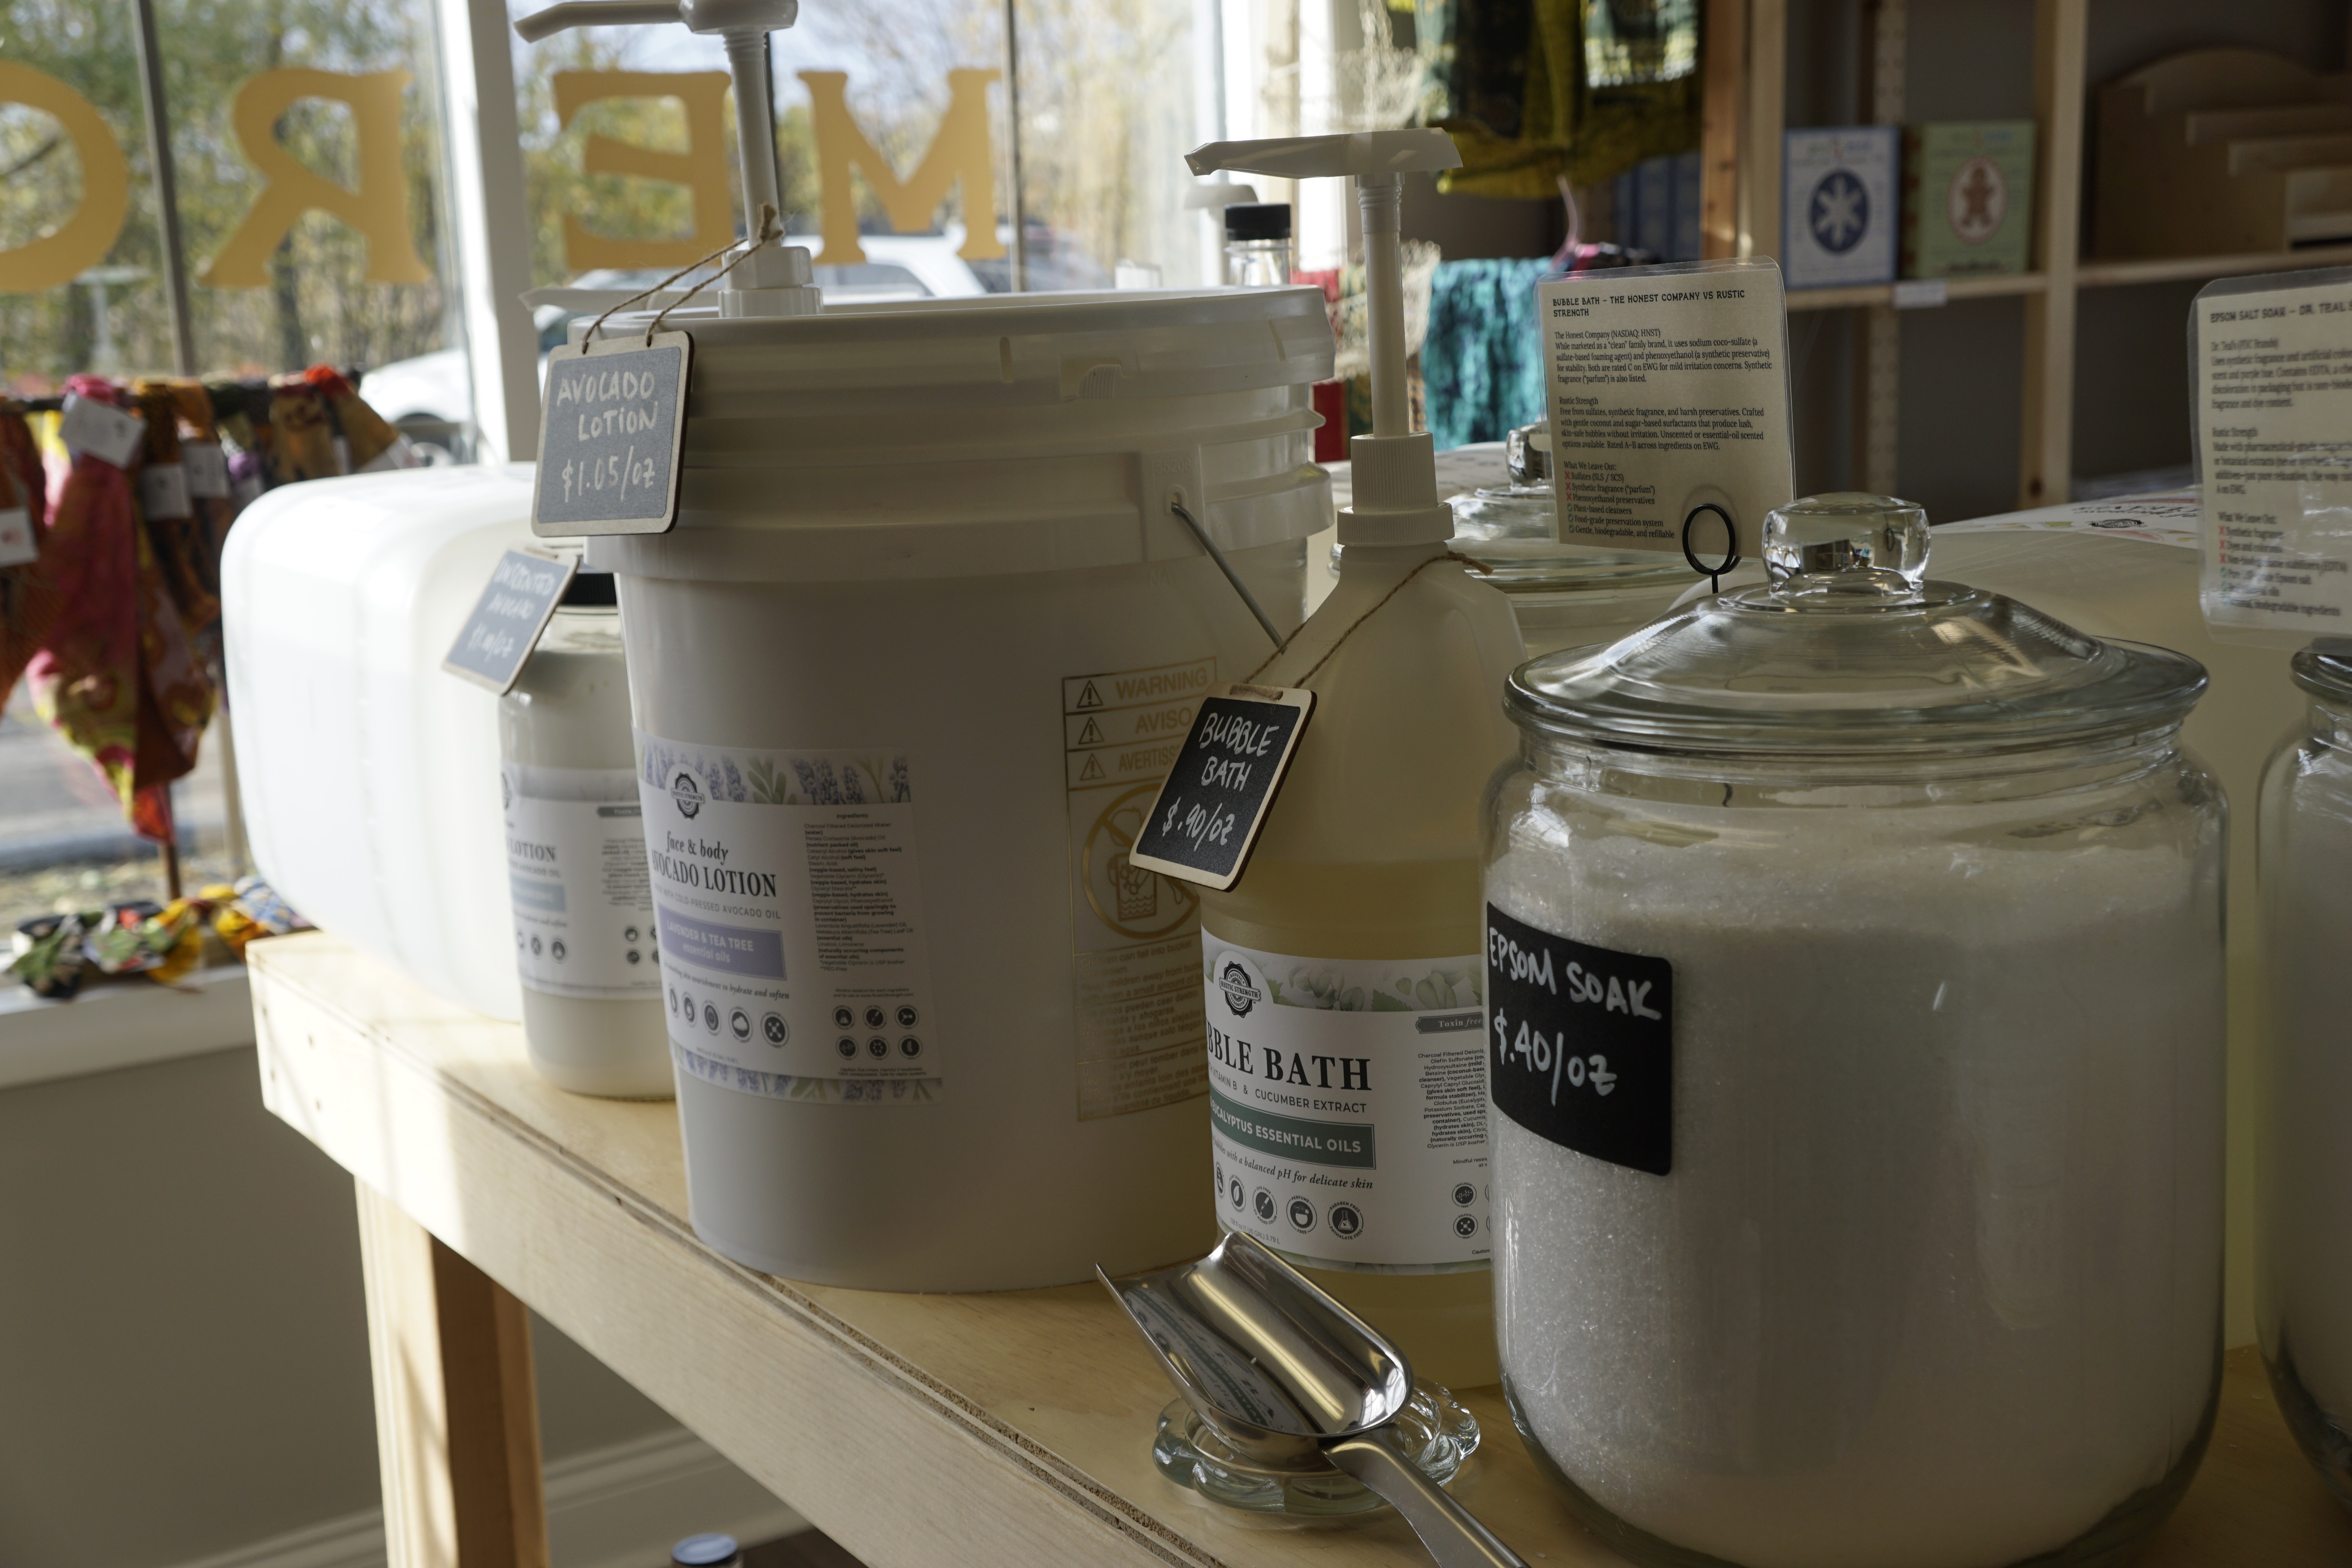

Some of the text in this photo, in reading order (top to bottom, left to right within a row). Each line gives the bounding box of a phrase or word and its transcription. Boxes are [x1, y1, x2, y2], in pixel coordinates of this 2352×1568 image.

[1552, 289, 1745, 307] BUBBLE BATH THE HONEST COMPANY VS RUSTIC
[1553, 308, 1589, 317] STRENGTH
[2211, 312, 2236, 323] EPSOM
[2239, 309, 2259, 320] SALT
[1554, 331, 1564, 339] The
[1584, 330, 1610, 340] Company
[1611, 329, 1640, 340] (NASDAQ:
[1641, 328, 1661, 338] HNST)
[1555, 341, 1570, 350] While
[1571, 341, 1596, 350] marketed
[1628, 339, 1646, 350] family
[1647, 339, 1667, 349] brand,
[1668, 339, 1673, 347] it
[1689, 338, 1712, 347] sodium
[1713, 337, 1751, 346] coco-sulfate
[1752, 336, 1758, 347] (a
[1556, 348, 1769, 362] sulfate-based foaming agent) and phenoxyethanol (a synthetic preservative)
[1565, 363, 1587, 374] stability.
[1587, 363, 1601, 372] Both
[1611, 363, 1627, 371] rated
[1627, 363, 1632, 371] C
[1642, 362, 1658, 371] EWG
[1659, 362, 1668, 370] for
[1669, 361, 1683, 370] mild
[1684, 361, 1712, 370] irritation
[1744, 360, 1772, 371] Synthetic
[557, 371, 655, 407] AVOCADO
[1575, 525, 1674, 539] Gentle, biodegradable, and refillable
[1115, 668, 1208, 699] WARNING
[1135, 707, 1192, 734] AVISO
[1199, 713, 1279, 757] BUBBLE
[1201, 756, 1252, 791] BATH
[510, 839, 556, 862] LOTION
[666, 831, 728, 865] face & body
[702, 866, 776, 897] LOTION
[675, 893, 719, 912] COLD-PRESSED
[723, 905, 761, 917] AVOCADO
[766, 910, 781, 919] OIL
[668, 920, 754, 951] LAVENDER & TEA TREE
[683, 943, 730, 963] essential oils
[1490, 927, 1662, 1020] EPSOM SOAK
[692, 975, 721, 989] nourishment
[730, 983, 752, 995] hydrate
[754, 988, 766, 997] and
[769, 989, 789, 1001] soften
[1221, 980, 1258, 998] RUSTIC STRENGTH
[1465, 1018, 1482, 1027] free
[1263, 1047, 1372, 1091] BATH
[1212, 1067, 1367, 1113] VITAMIN B & CUCUMBER EXTRACT
[1213, 1100, 1361, 1152] EUCALYPTUS ESSENTIAL OILS
[1227, 1150, 1237, 1162] with
[1244, 1157, 1275, 1175] balanced
[1277, 1169, 1292, 1180] pH
[1292, 1171, 1307, 1183] for
[1310, 1174, 1348, 1188] delicate
[1350, 1178, 1373, 1189] skin
[1329, 1201, 1361, 1213] PARABEN FREE
[1254, 1231, 1265, 1240] GAL)
[1329, 1226, 1363, 1240] PHTHALATE FREE
